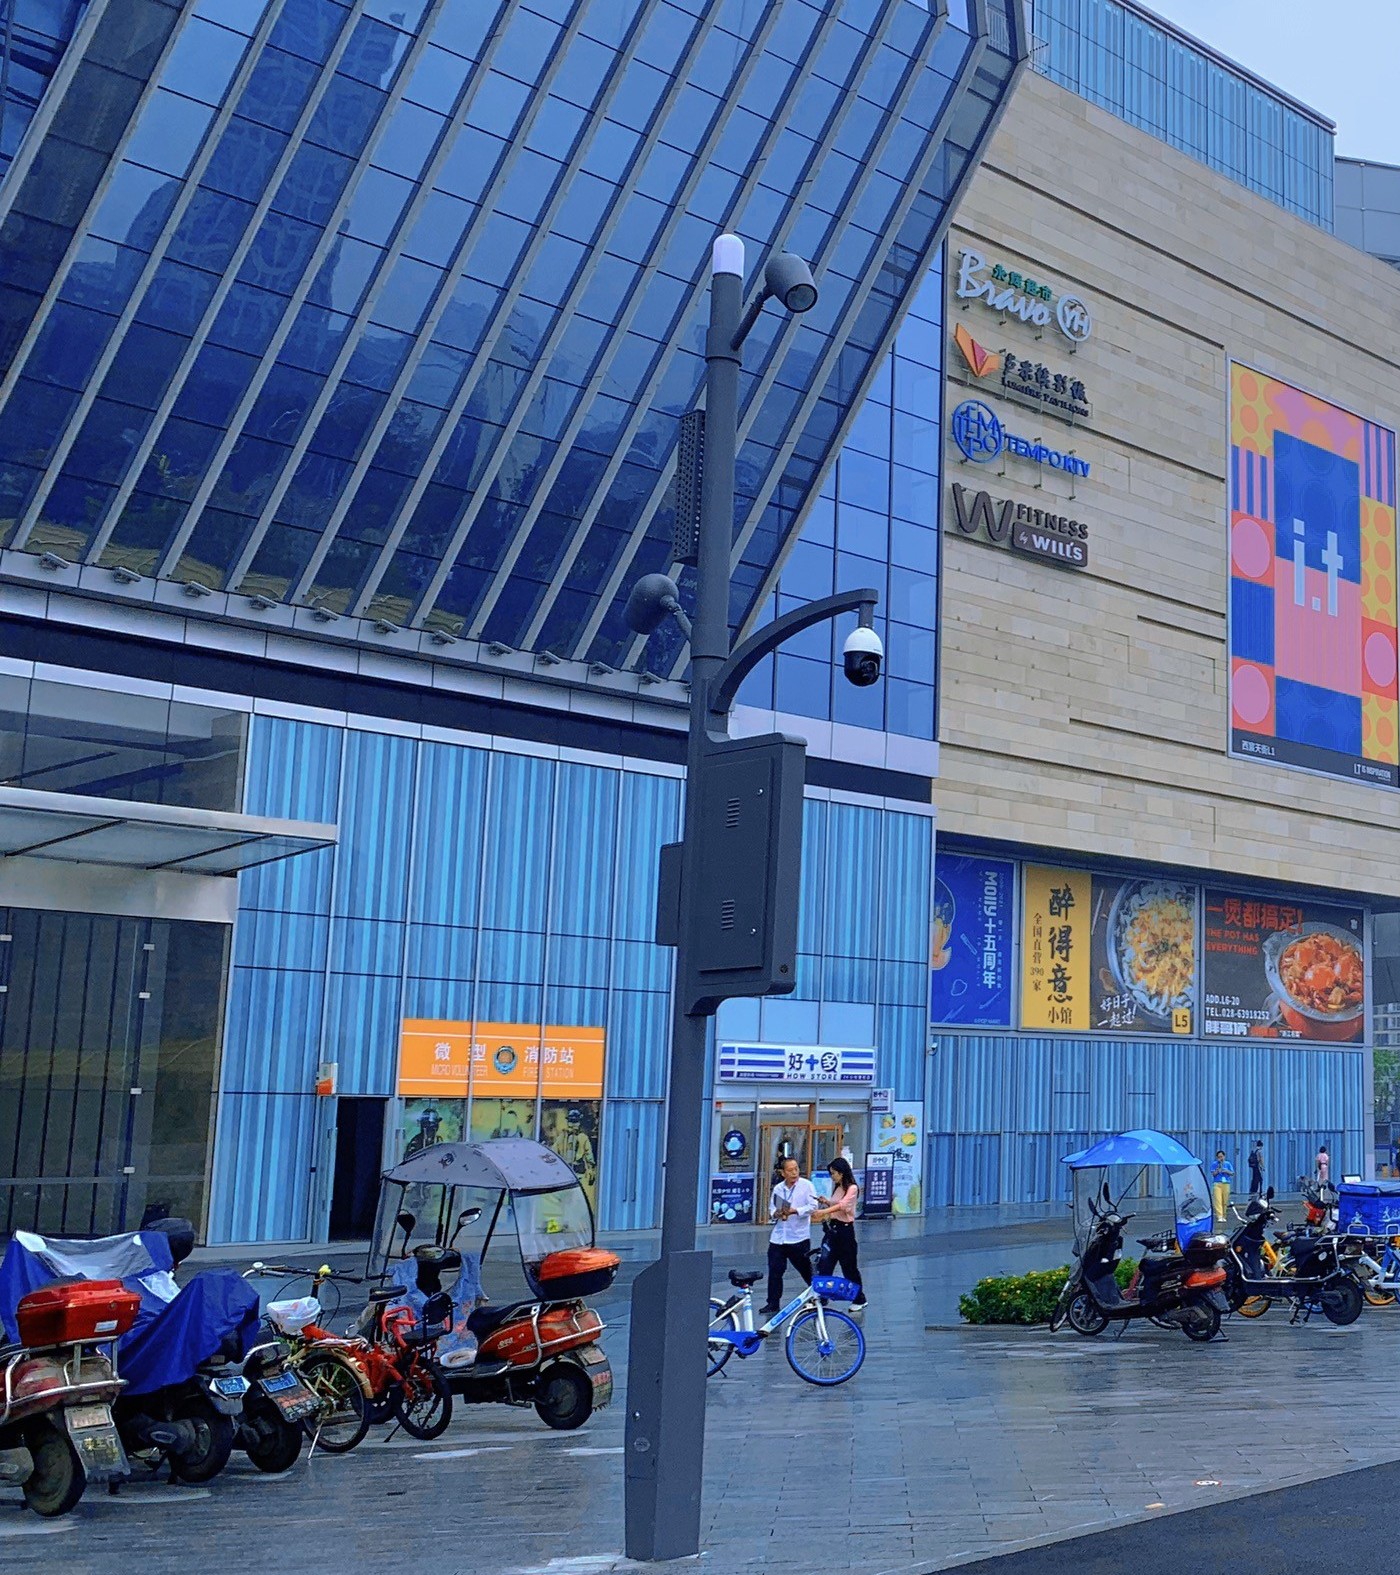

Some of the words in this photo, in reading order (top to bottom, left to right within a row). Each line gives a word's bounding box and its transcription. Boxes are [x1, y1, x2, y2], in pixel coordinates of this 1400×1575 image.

[956, 247, 1051, 326] Bravo
[1004, 433, 1061, 469] TEMPO
[1063, 456, 1091, 478] KTV
[1017, 503, 1089, 540] FITNESS
[1293, 517, 1344, 617] i.t
[1206, 898, 1304, 934] 一煲都搞定!
[1048, 883, 1075, 1004] 醉得意
[1224, 930, 1241, 940] POT
[1243, 932, 1260, 942] HAS
[1030, 913, 1044, 992] 全国直营390家
[1206, 941, 1258, 955] EVERYTHING
[1100, 993, 1130, 1012] 好日子
[1048, 1006, 1073, 1025] 小馆
[1097, 1004, 1137, 1028] 一起过!
[1175, 1014, 1188, 1028] L5
[524, 1045, 575, 1065] 消防站
[546, 1067, 574, 1079] STATION
[811, 1073, 838, 1081] STORE
